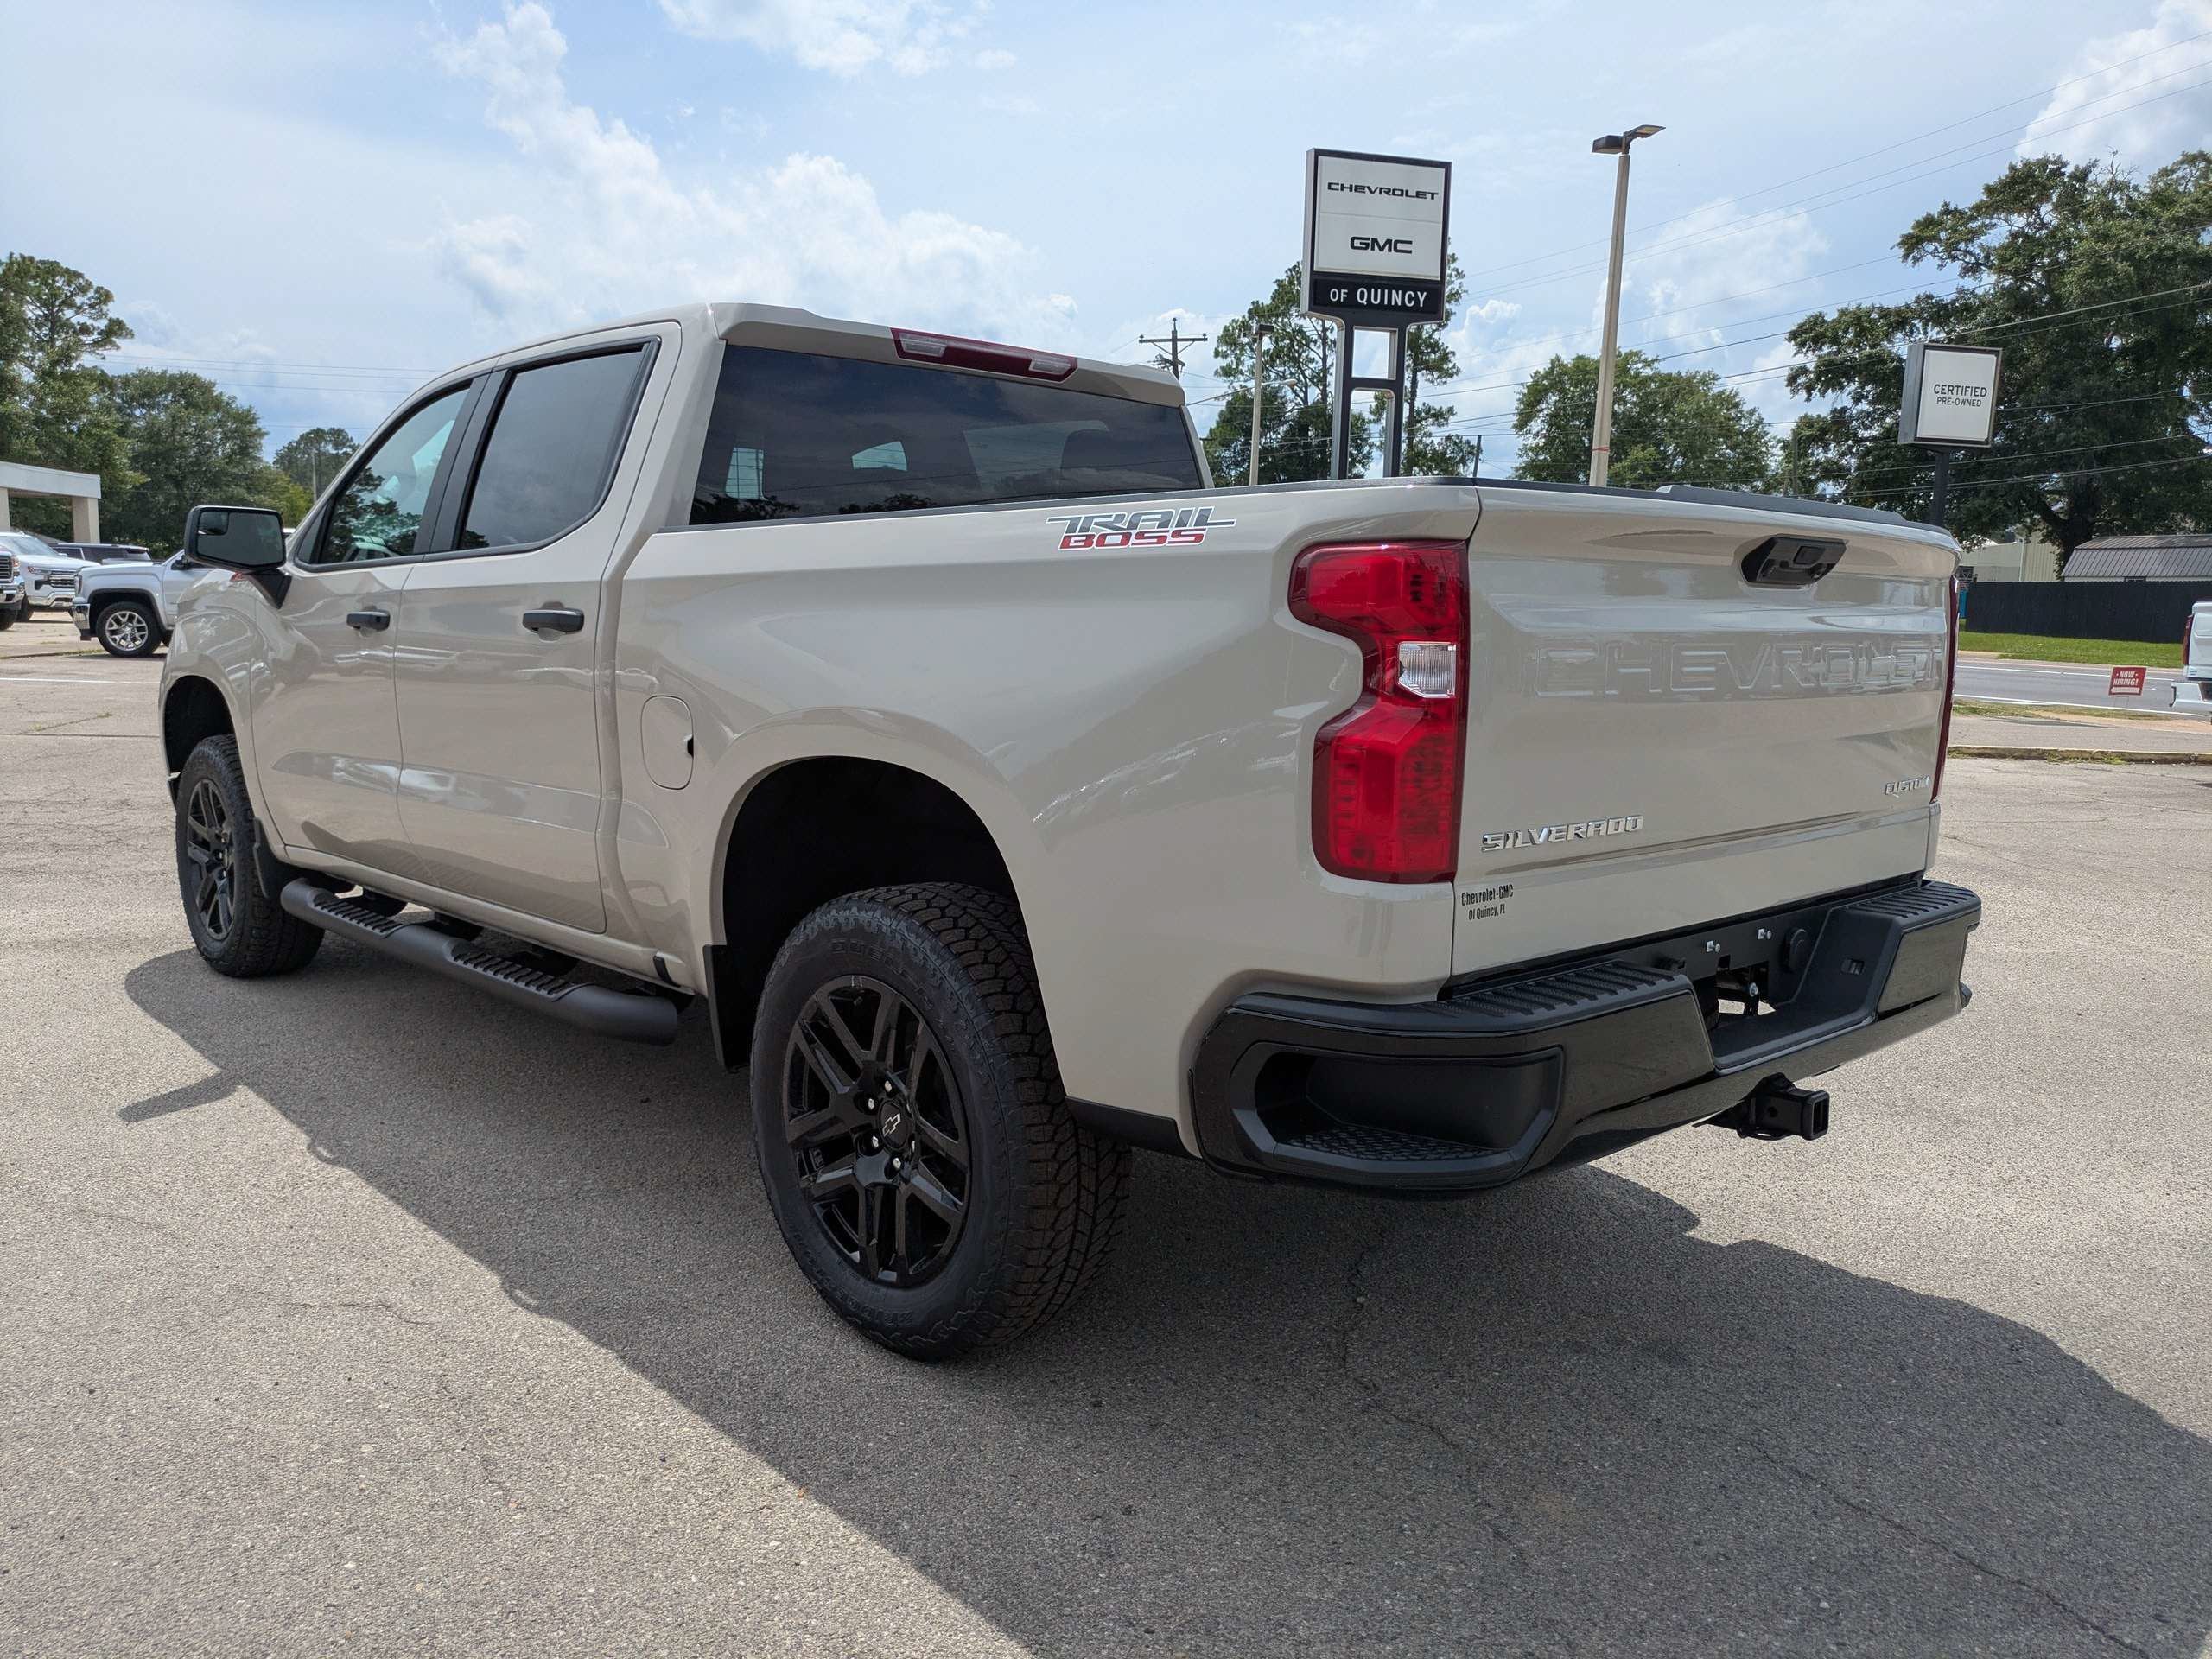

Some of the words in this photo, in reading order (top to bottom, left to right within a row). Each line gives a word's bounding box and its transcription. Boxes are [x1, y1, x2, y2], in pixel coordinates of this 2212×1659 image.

[1327, 181, 1439, 200] CHEVROLET
[1350, 236, 1413, 254] GMC
[1330, 289, 1349, 302] OF
[1357, 287, 1427, 308] QUINCY
[1934, 384, 1987, 397] CERTIFIED
[1936, 397, 1982, 407] PRE-OWNED
[1046, 505, 1236, 534] TRAIL
[1058, 527, 1208, 551] BOSS
[1535, 641, 1943, 696] CHEVROLET
[1480, 815, 1644, 853] SILVERADO
[1461, 884, 1514, 906] Chevrolet-GMC
